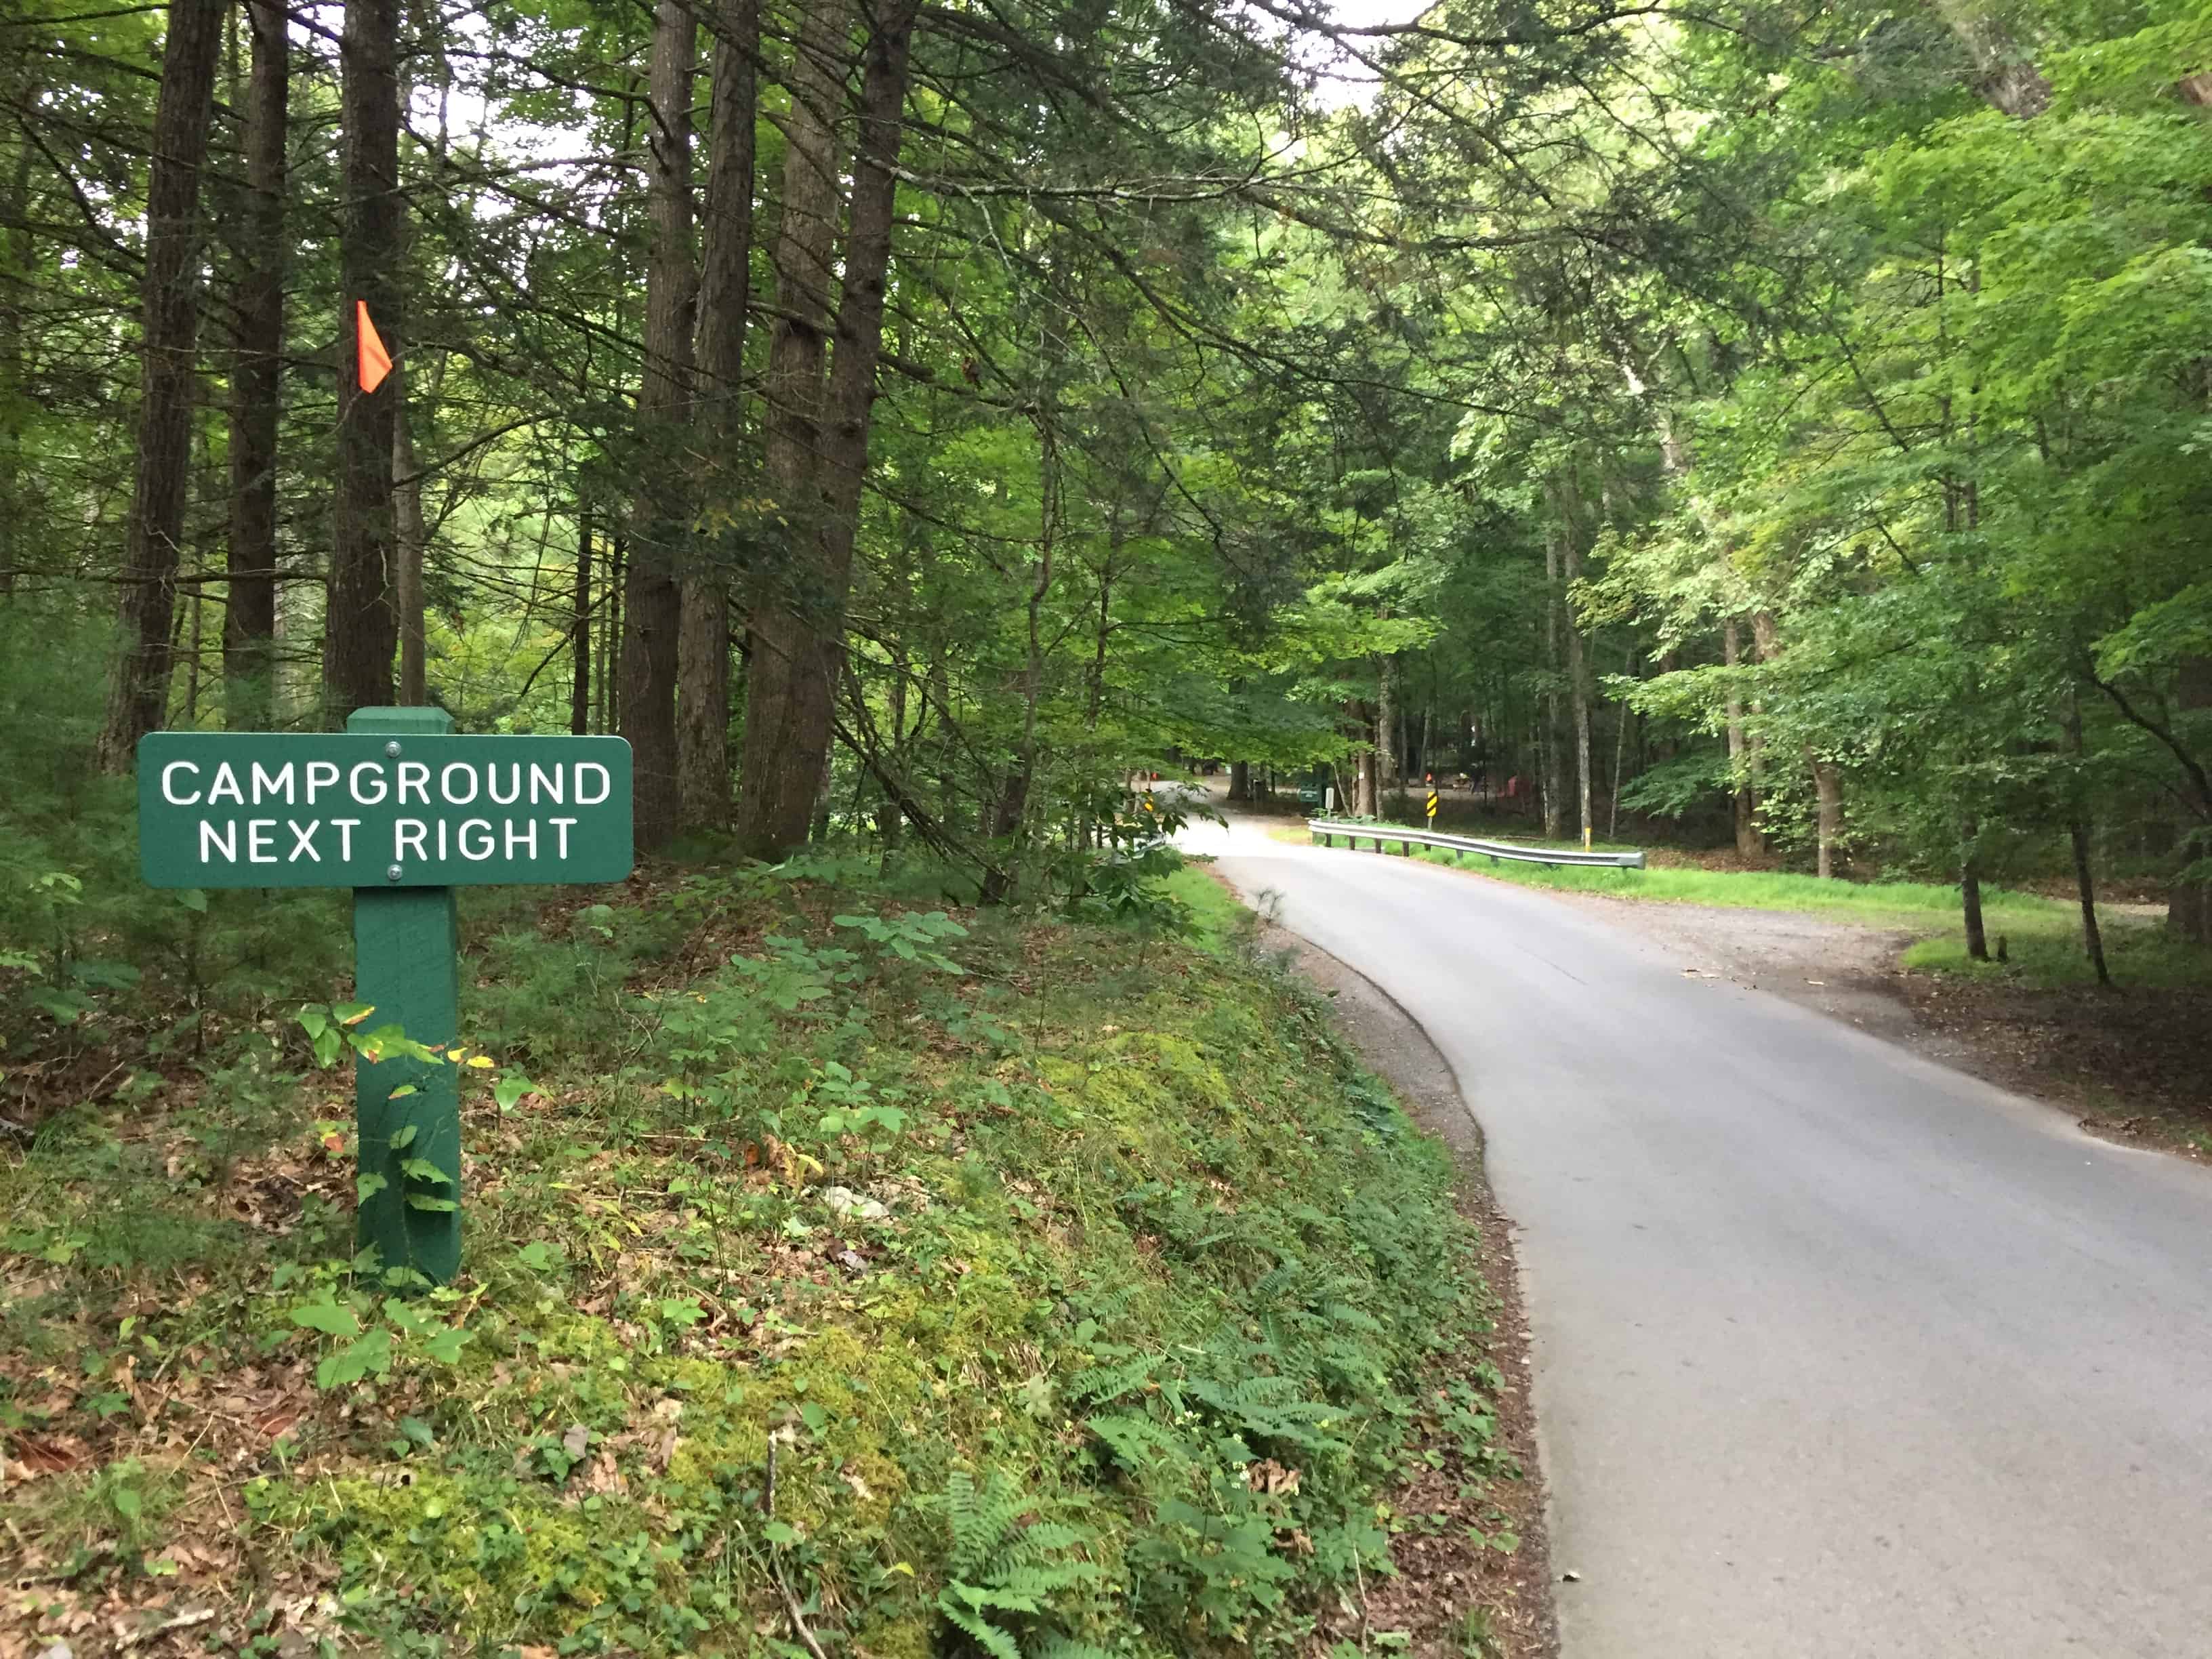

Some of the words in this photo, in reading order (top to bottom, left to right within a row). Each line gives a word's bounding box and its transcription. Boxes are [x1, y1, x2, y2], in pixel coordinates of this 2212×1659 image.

[161, 760, 611, 806] CAMPGROUND
[199, 818, 362, 863] NEXT
[394, 817, 578, 862] RIGHT
